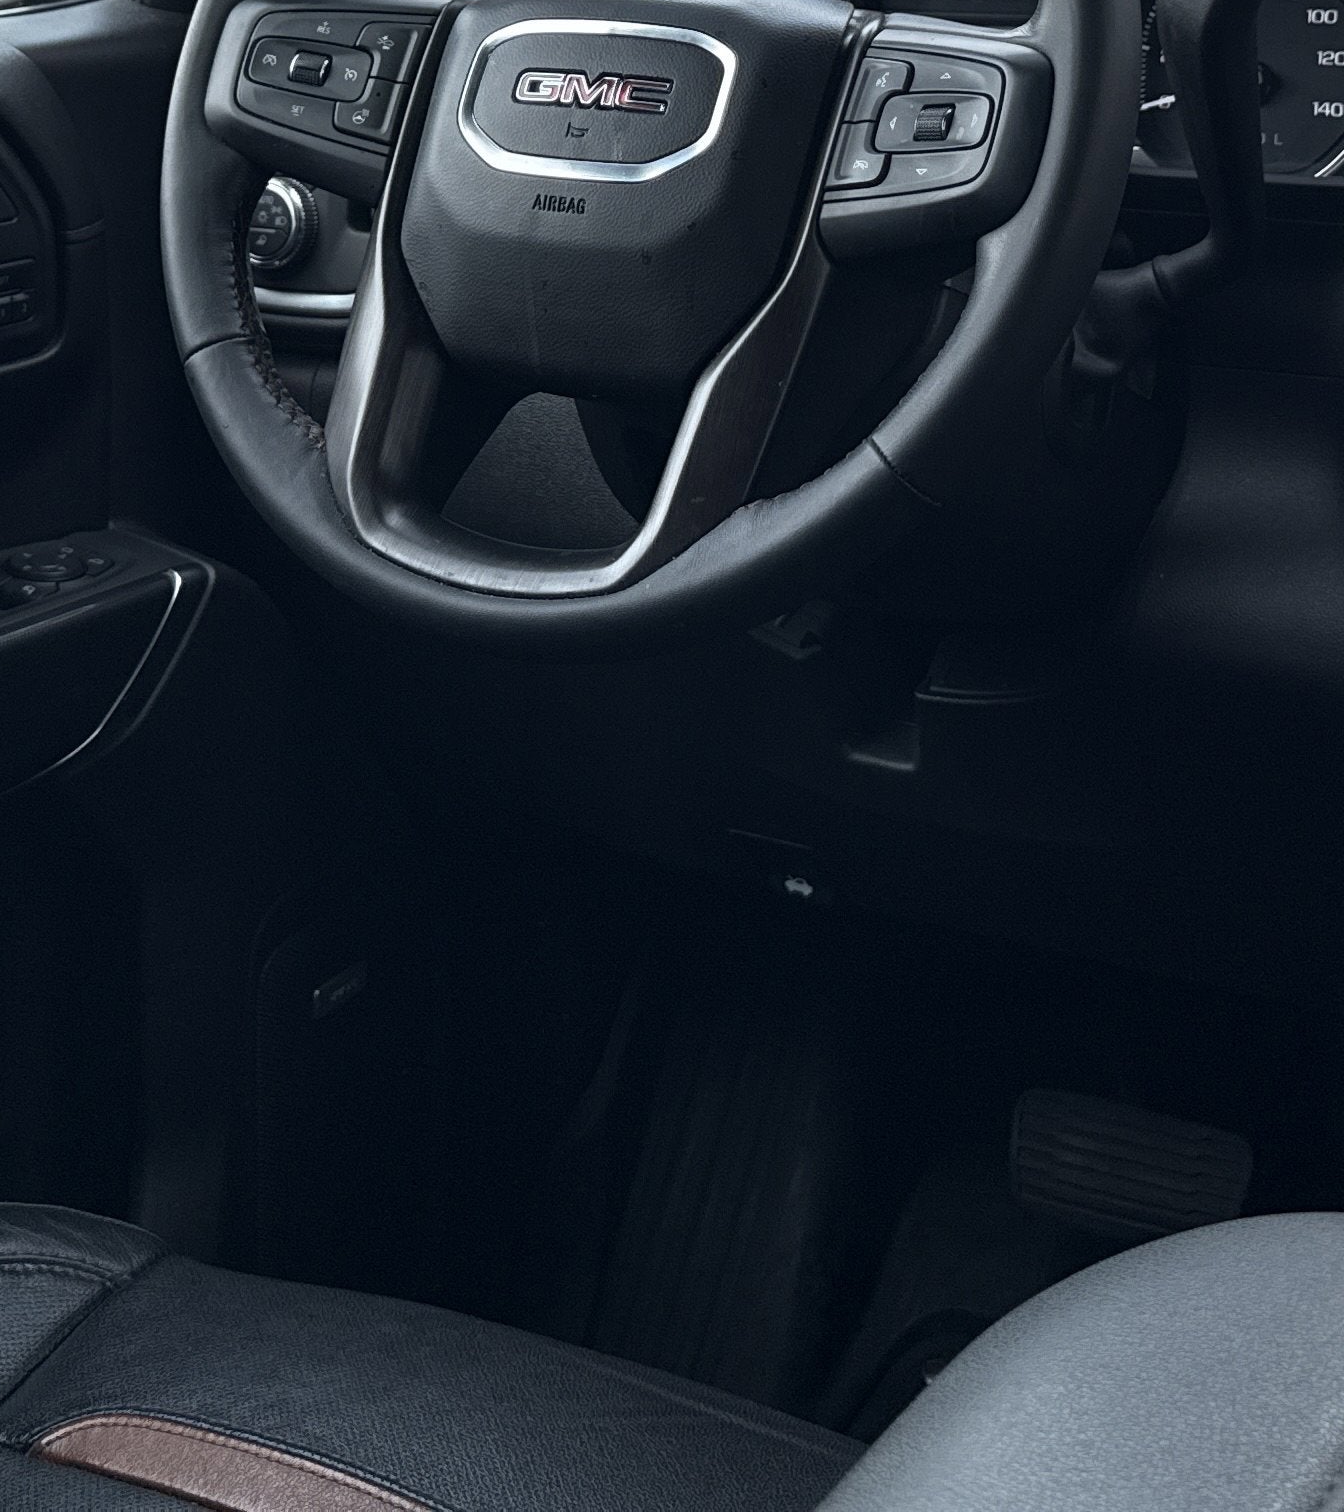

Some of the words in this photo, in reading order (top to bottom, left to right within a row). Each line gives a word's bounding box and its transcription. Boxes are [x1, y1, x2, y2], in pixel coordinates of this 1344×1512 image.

[1306, 8, 1338, 24] 100
[515, 71, 672, 113] GMC
[1312, 101, 1344, 117] 140
[532, 193, 587, 214] AIRBAG
